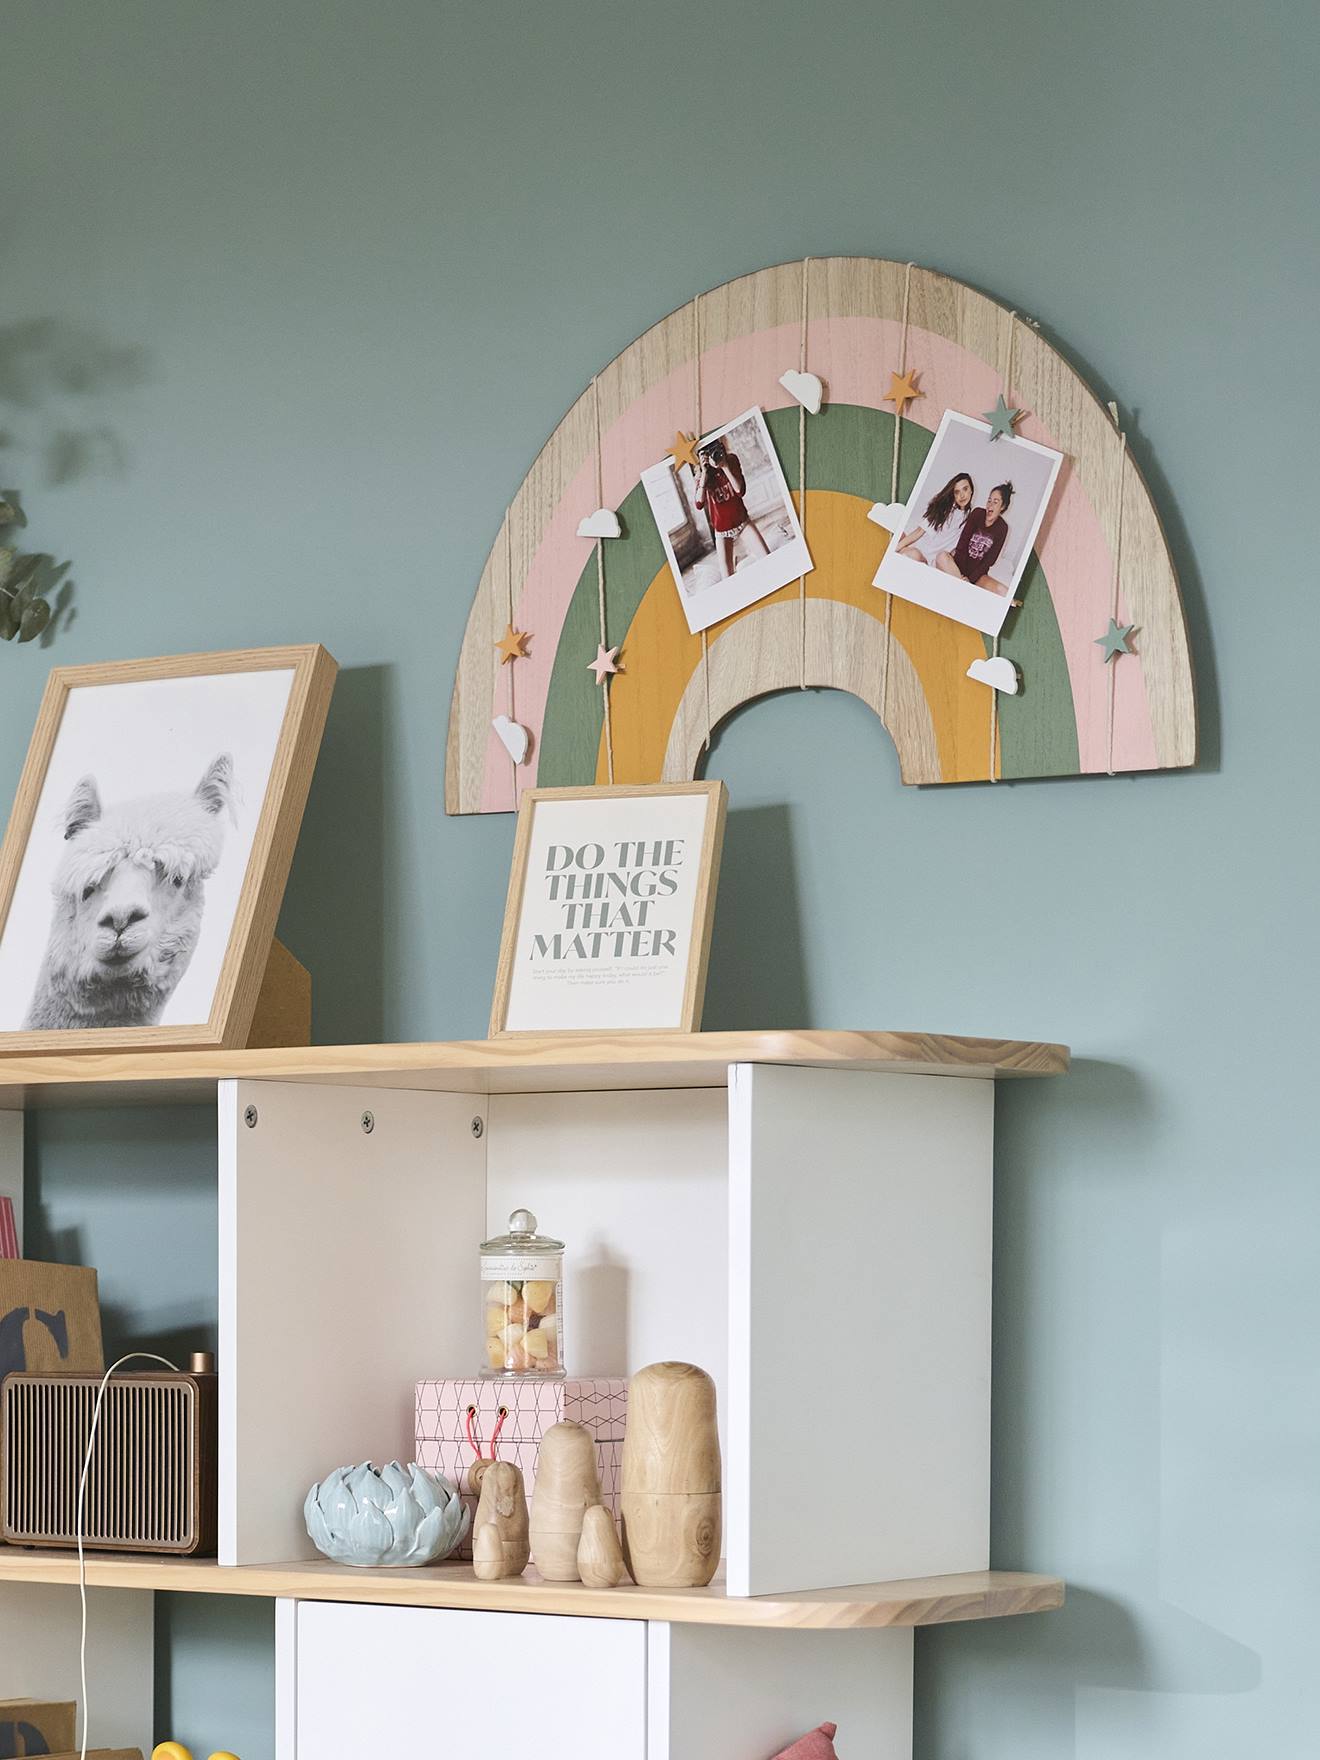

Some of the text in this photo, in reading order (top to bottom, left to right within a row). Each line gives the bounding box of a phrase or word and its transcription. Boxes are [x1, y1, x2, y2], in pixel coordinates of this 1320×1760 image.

[546, 839, 685, 871] DO THE
[544, 869, 679, 900] THINGS
[561, 900, 655, 929] THAT
[529, 929, 677, 961] MATTER
